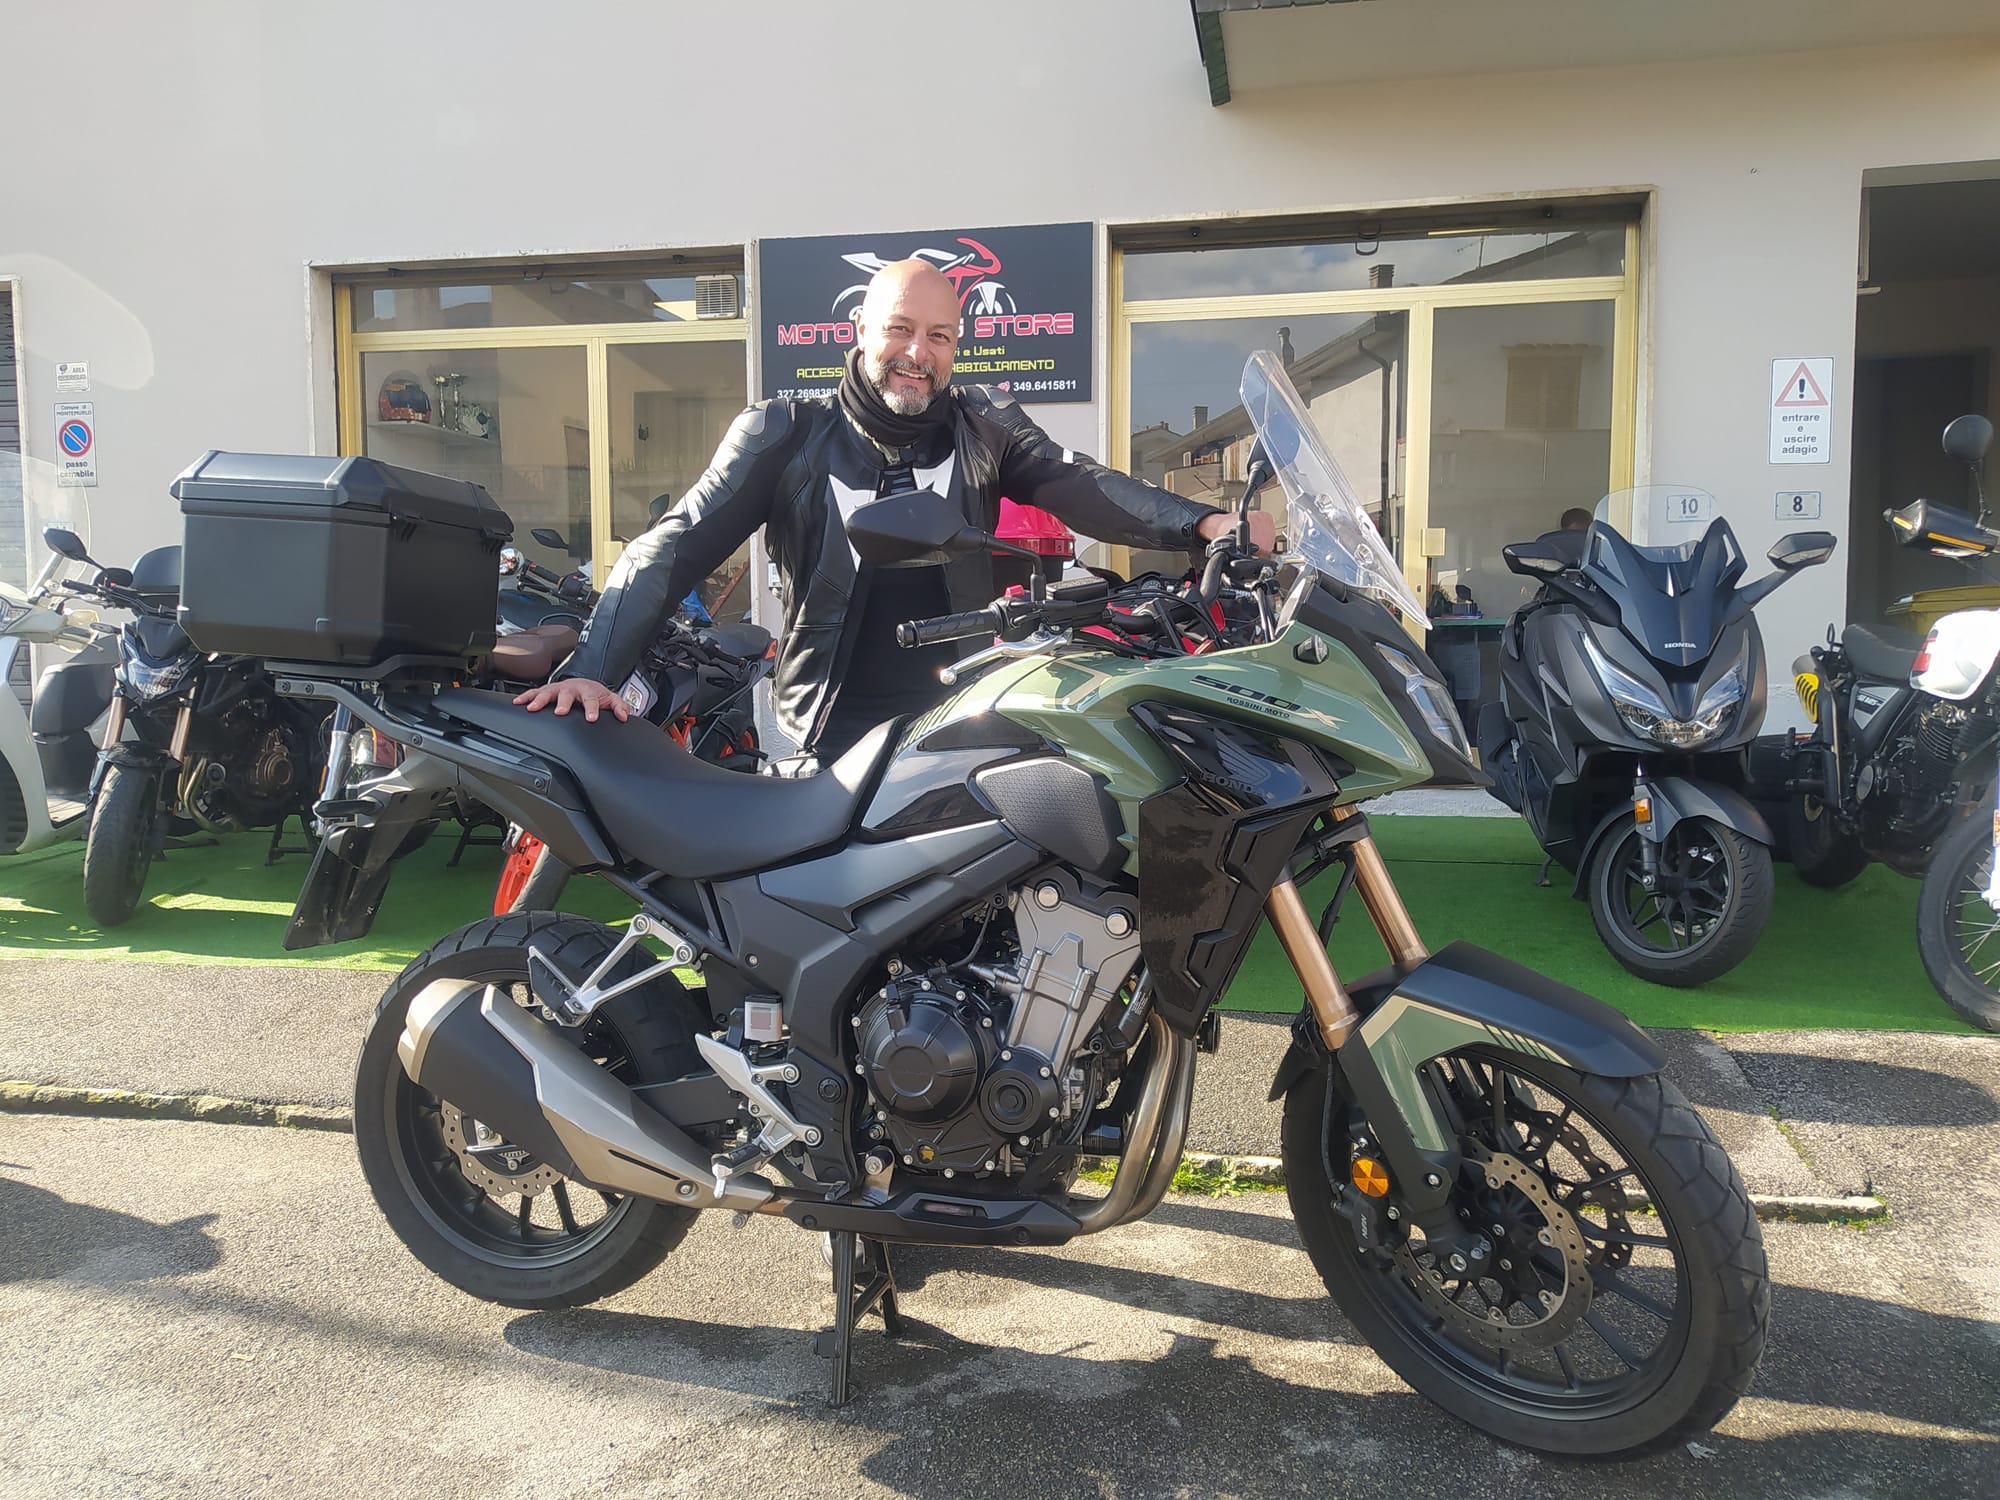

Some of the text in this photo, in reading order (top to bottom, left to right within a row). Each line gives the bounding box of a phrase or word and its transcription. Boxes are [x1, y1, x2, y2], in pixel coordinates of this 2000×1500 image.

[975, 312, 1073, 338] STORE
[778, 322, 853, 345] MOTO
[973, 345, 1005, 356] Usati
[1013, 380, 1077, 391] 349.6415811
[1782, 414, 1820, 422] entrare
[1784, 434, 1817, 443] uscire
[1782, 444, 1818, 455] adagio
[1680, 498, 1698, 515] 10
[1793, 495, 1803, 513] 8
[1664, 641, 1697, 649] HONDA
